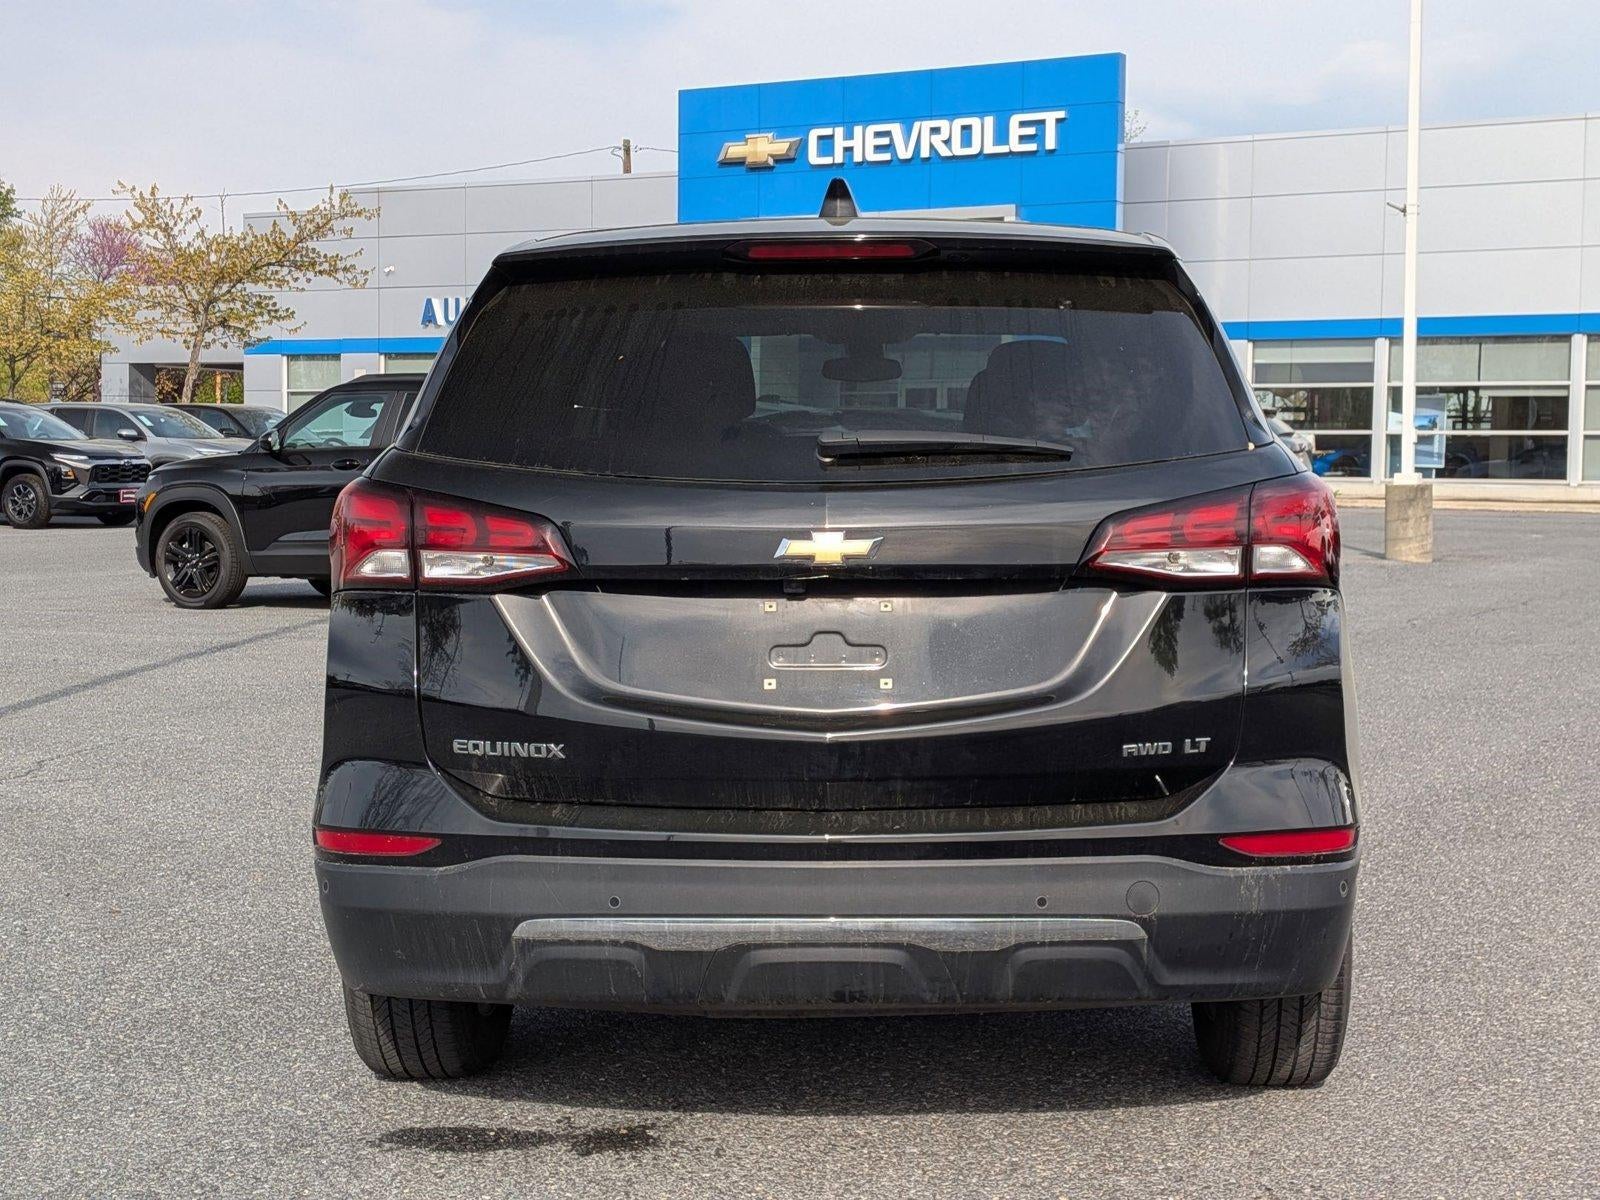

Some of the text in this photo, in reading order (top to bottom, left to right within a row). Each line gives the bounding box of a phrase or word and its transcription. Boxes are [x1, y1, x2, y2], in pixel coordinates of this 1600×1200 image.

[807, 110, 1066, 165] CHEVROLET
[421, 297, 469, 326] AU
[452, 739, 566, 759] EQUINOX
[1122, 737, 1211, 757] AWD LT
